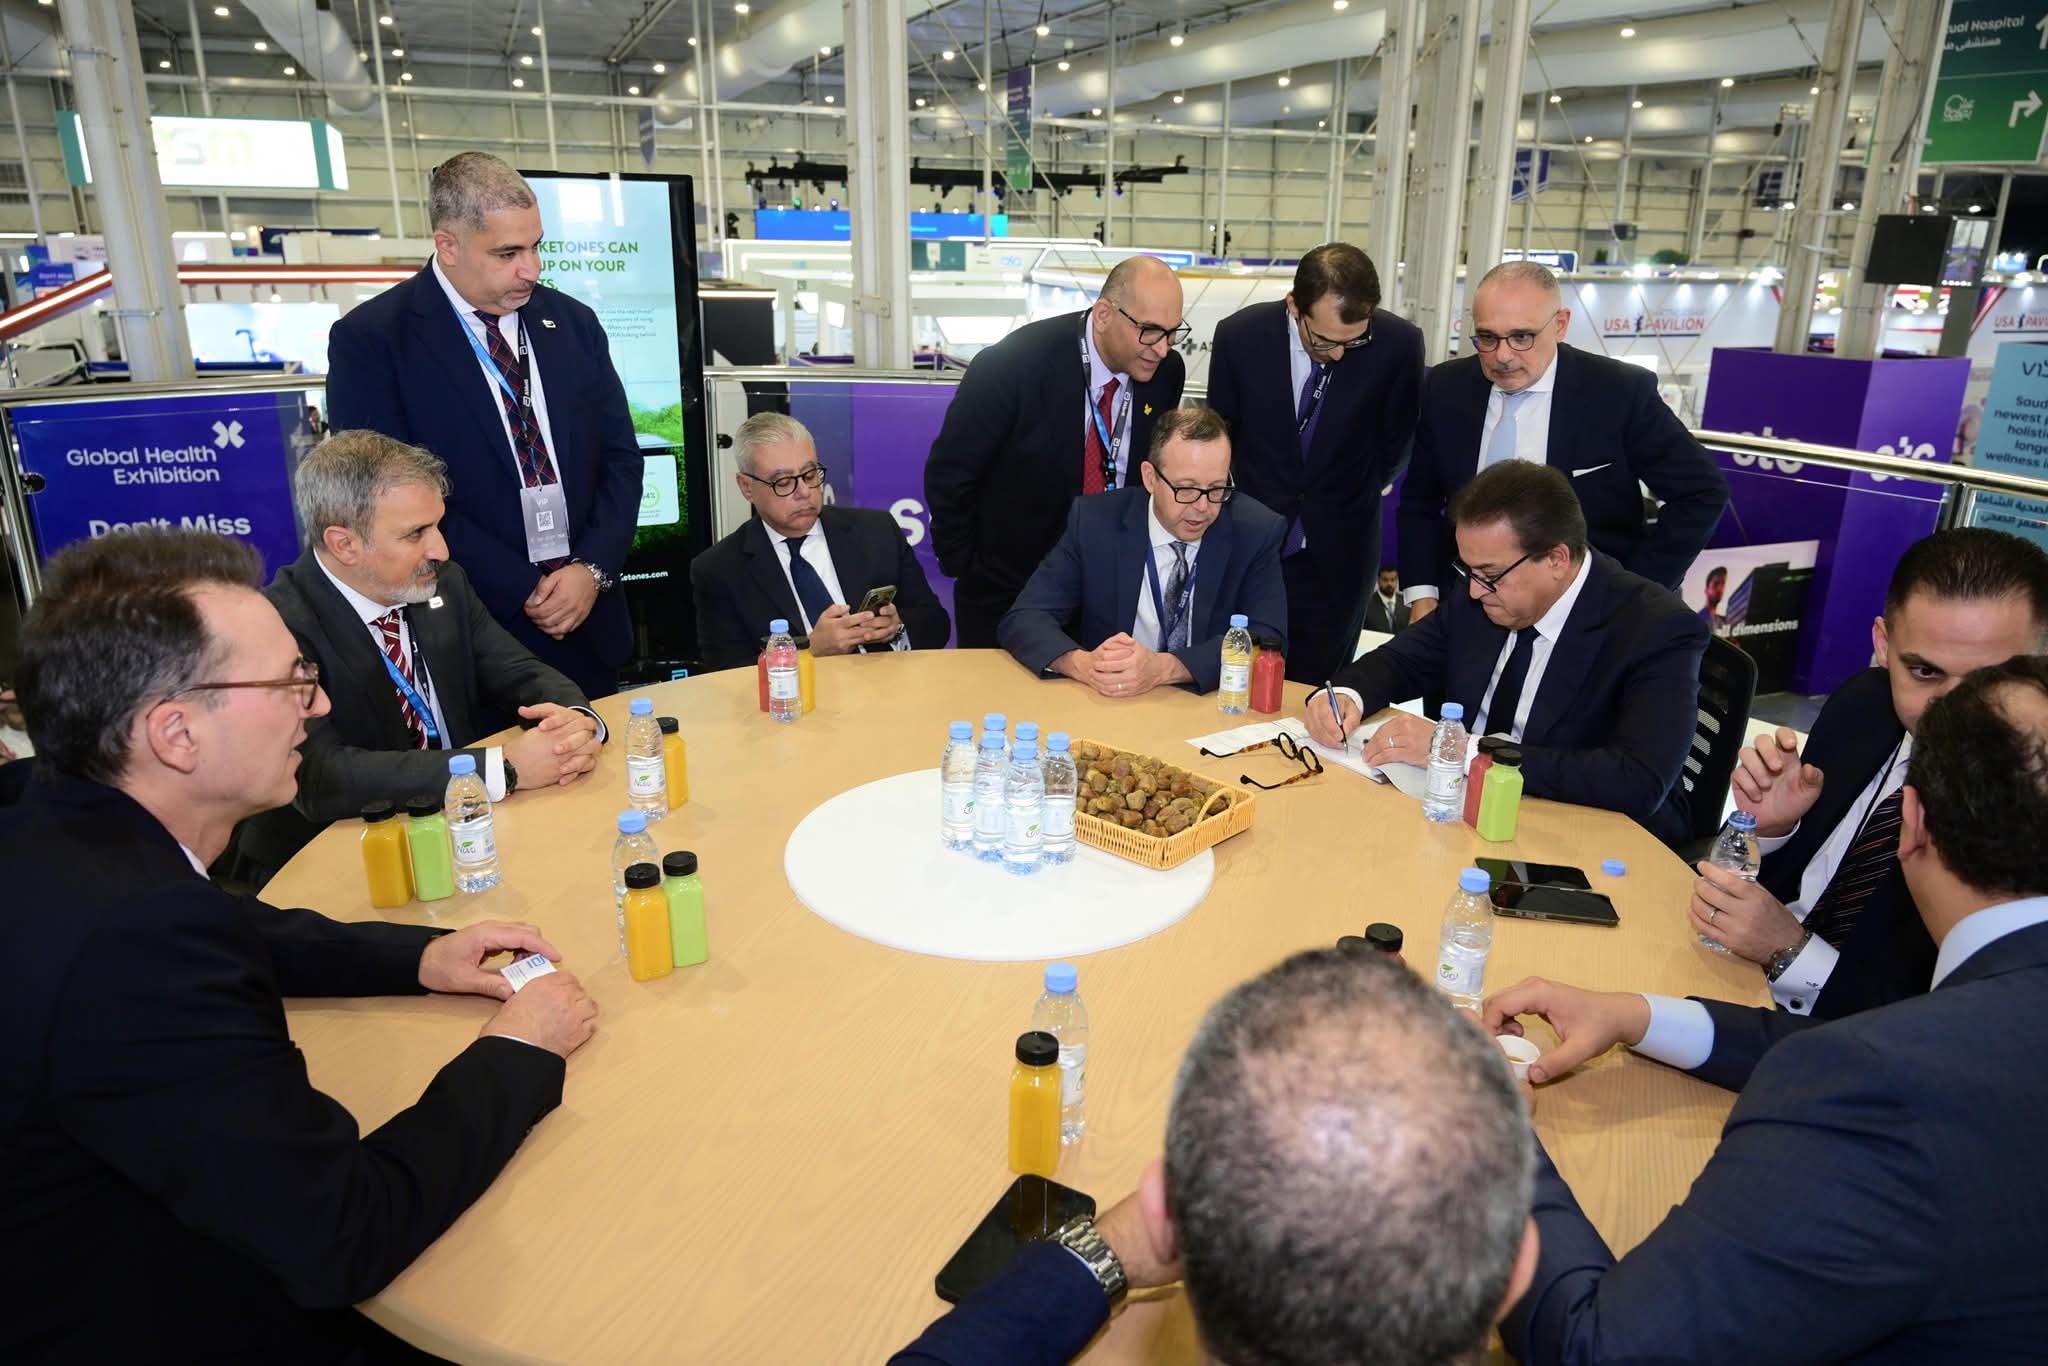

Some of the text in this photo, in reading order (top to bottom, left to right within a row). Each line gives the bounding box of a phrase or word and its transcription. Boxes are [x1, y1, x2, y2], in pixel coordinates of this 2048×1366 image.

[1971, 15, 2025, 33] Hospital
[539, 241, 639, 253] KETONES CAN
[559, 260, 582, 271] ON
[583, 260, 625, 271] YOUR
[1604, 317, 1706, 332] USA PAVILION
[1994, 315, 2015, 328] USA
[1993, 409, 2041, 423] newest
[66, 446, 217, 466] Global Health
[1985, 451, 2040, 467] wellness
[113, 466, 220, 485] Exhibition
[181, 513, 252, 536] Miss
[1732, 619, 1799, 637] dimensions
